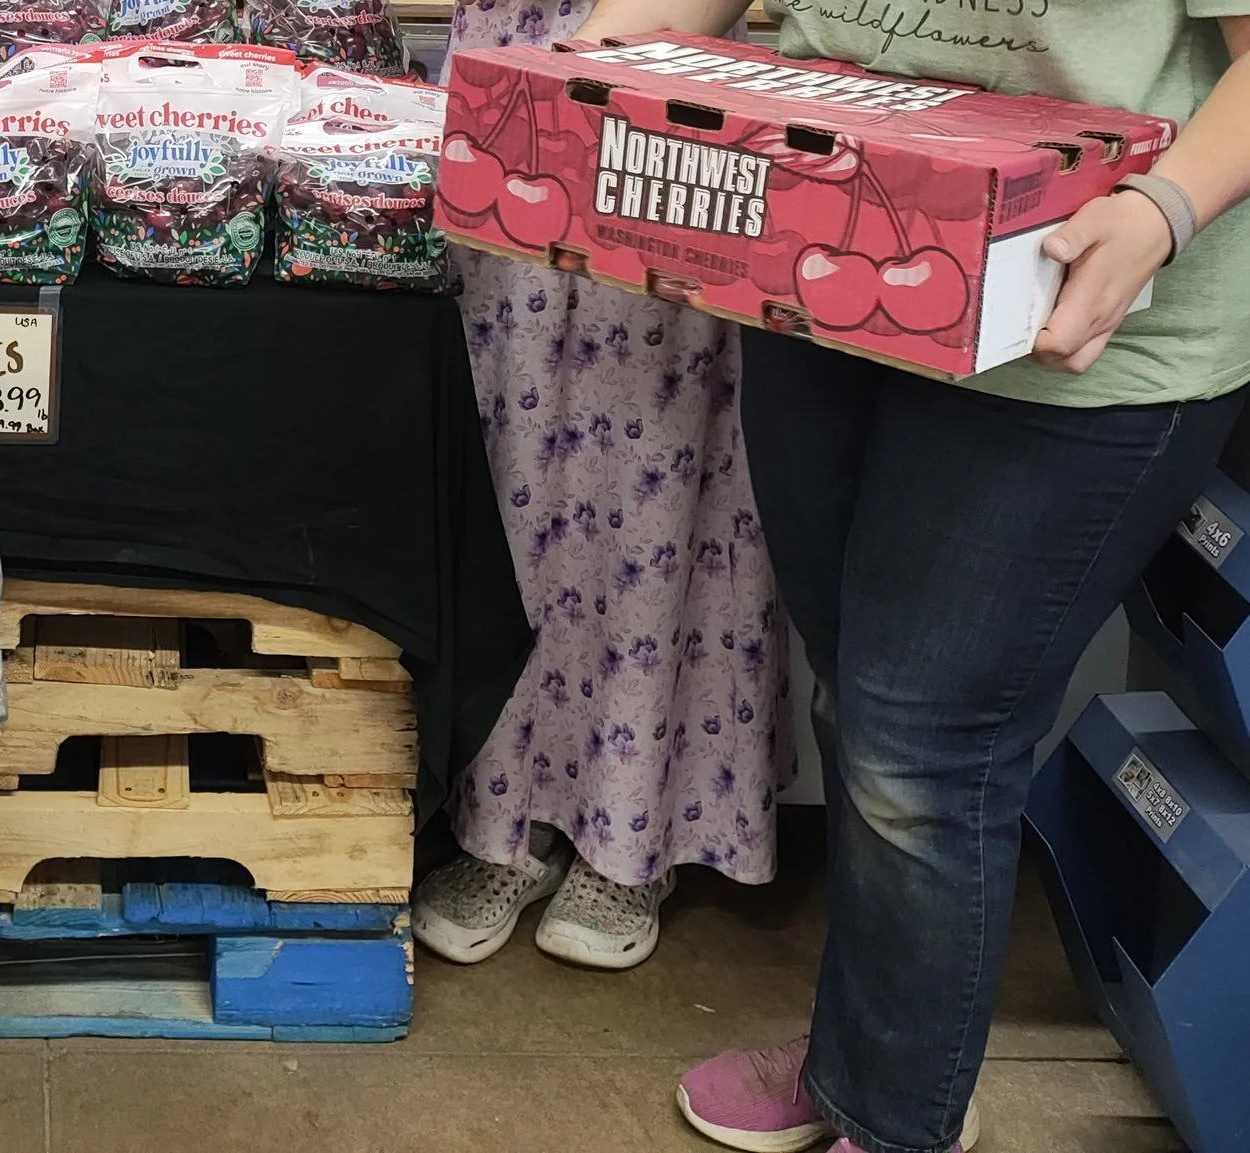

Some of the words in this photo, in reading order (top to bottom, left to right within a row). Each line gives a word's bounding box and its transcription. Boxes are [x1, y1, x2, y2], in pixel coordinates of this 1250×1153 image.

[24, 9, 70, 22] douces
[140, 5, 170, 24] grown
[217, 49, 241, 59] sweet
[243, 51, 276, 62] cherries
[576, 49, 943, 111] CHERRIES
[617, 41, 976, 102] NORTHWEST
[149, 102, 268, 139] cherries
[126, 137, 214, 169] joyfully
[599, 115, 771, 197] NORTHWEST
[153, 165, 197, 182] grown
[358, 171, 403, 186] grown
[106, 186, 164, 204] cerises
[374, 192, 426, 210] douces
[595, 171, 766, 238] CHERRIES
[598, 224, 680, 260] WASHINGTON
[685, 247, 750, 278] CHERRIES
[14, 317, 38, 328] USA
[26, 423, 45, 433] Box
[1198, 534, 1220, 557] Prints
[1206, 522, 1231, 547] 4x6
[1146, 790, 1161, 806] 5x7
[1158, 804, 1176, 826] 8x12
[1153, 782, 1167, 798] 4x8
[1164, 795, 1183, 816] 8x10
[1145, 806, 1163, 827] Prints
